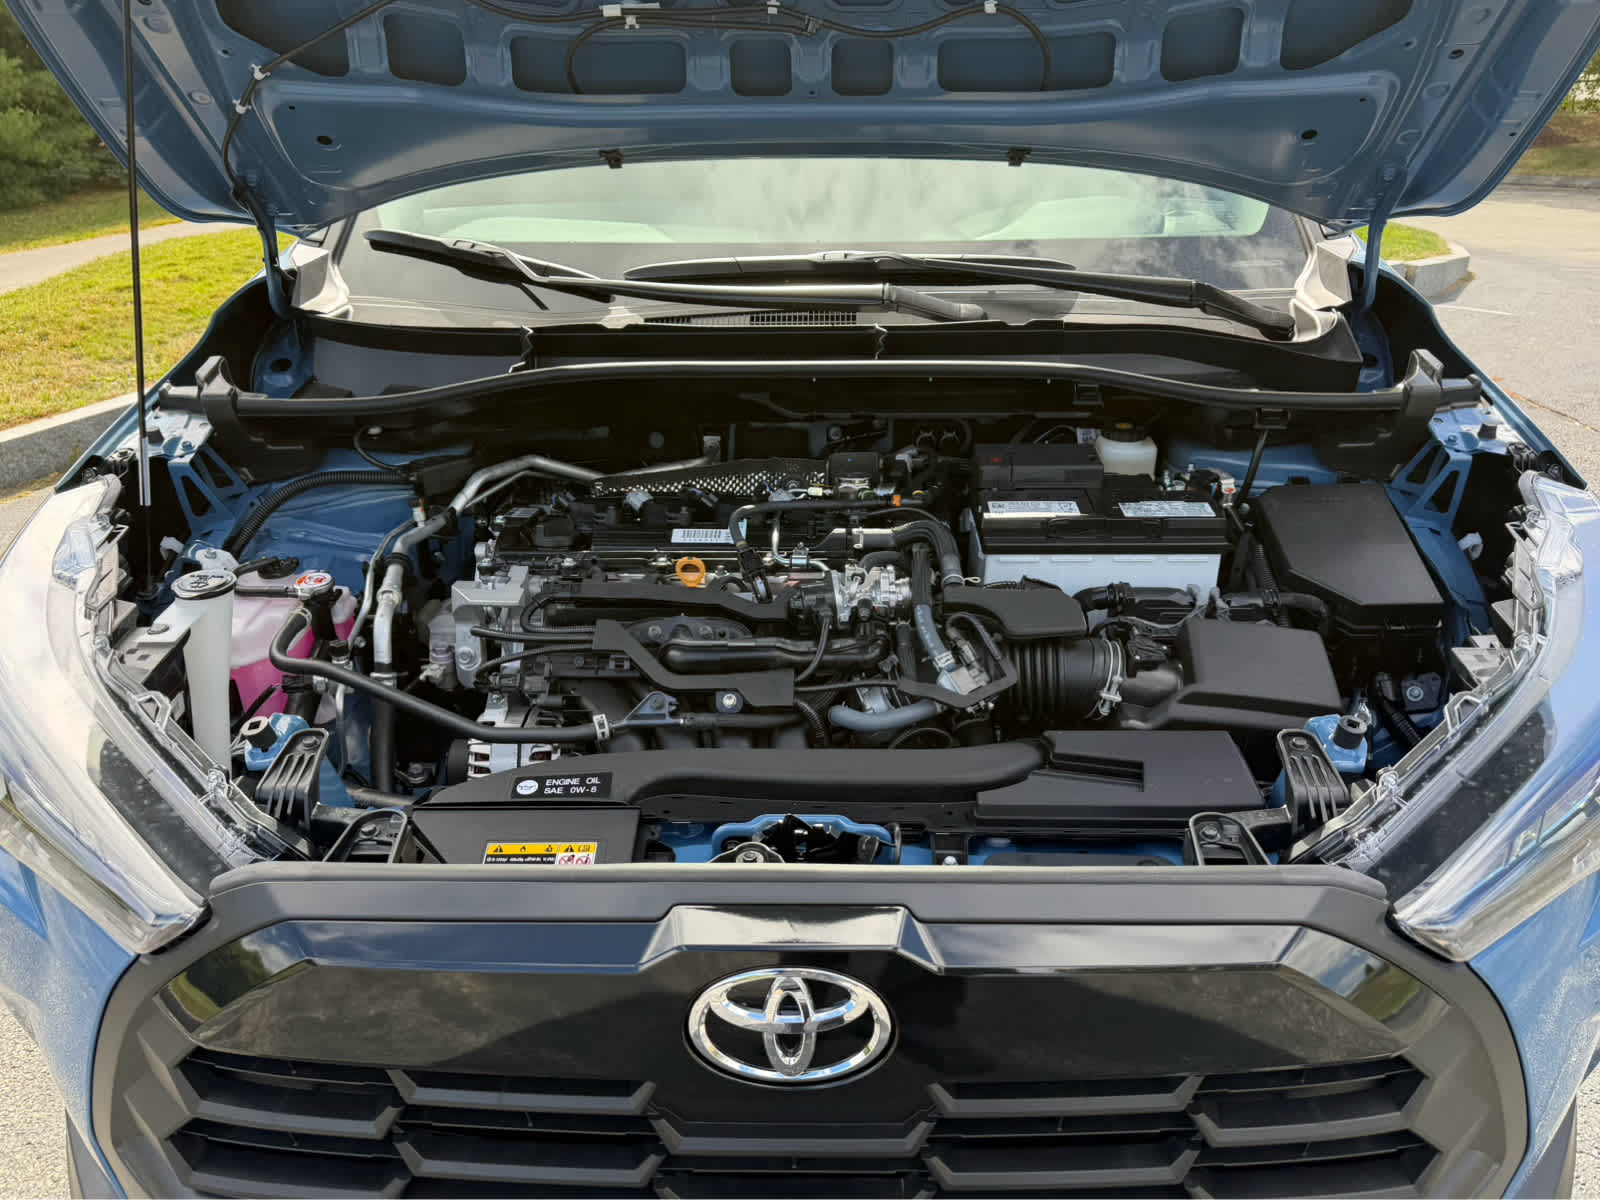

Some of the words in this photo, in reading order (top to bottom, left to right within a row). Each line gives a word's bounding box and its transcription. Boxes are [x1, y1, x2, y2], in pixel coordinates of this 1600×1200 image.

[545, 778, 580, 786] ENGINE
[585, 776, 601, 784] OIL
[543, 786, 564, 794] SAE
